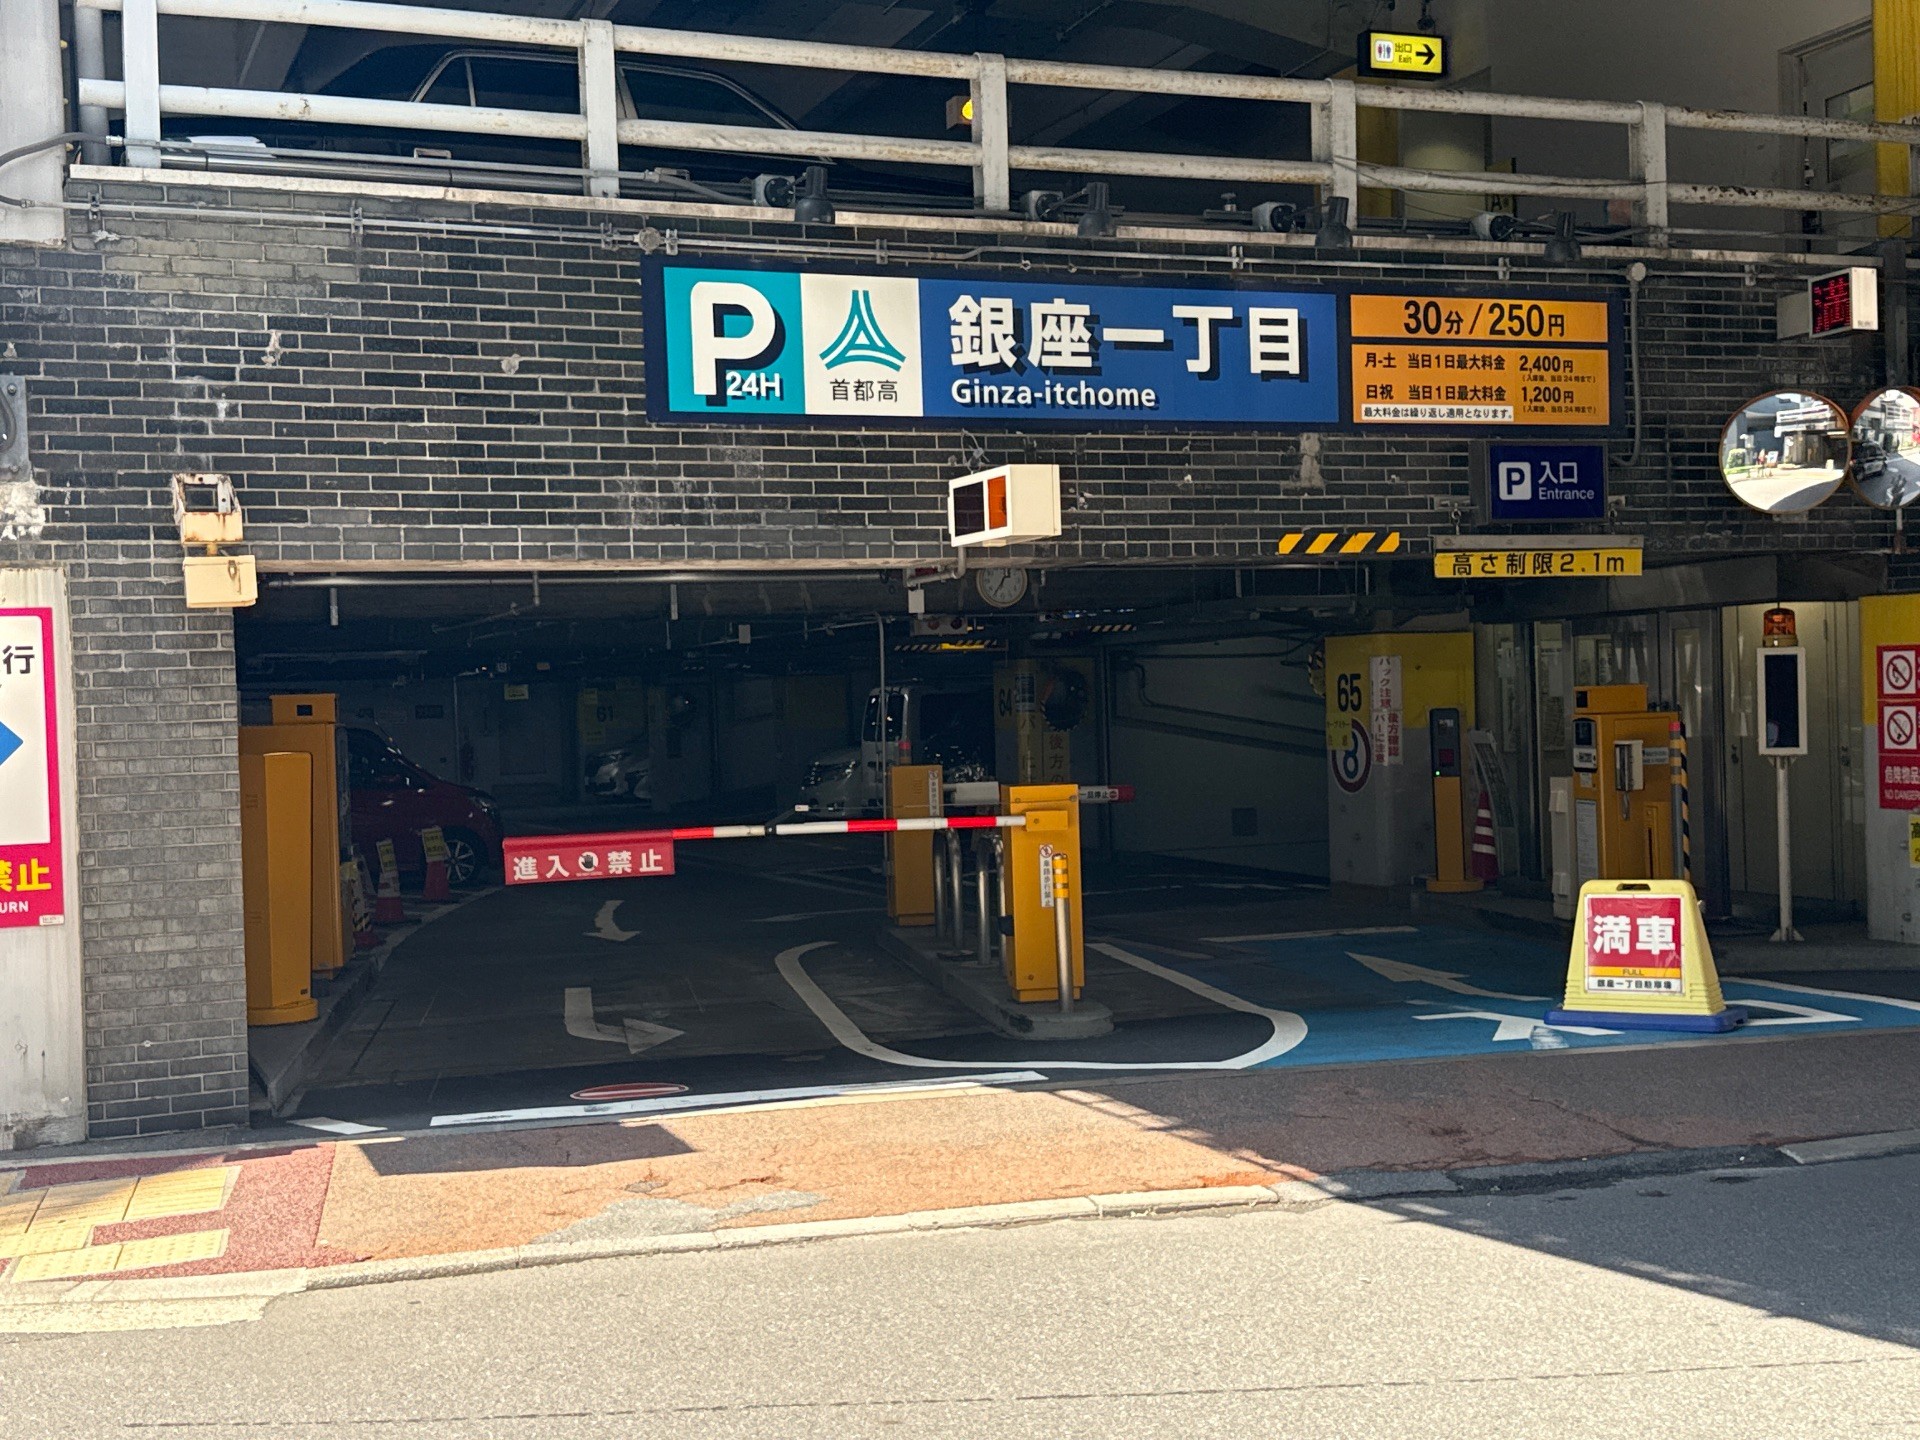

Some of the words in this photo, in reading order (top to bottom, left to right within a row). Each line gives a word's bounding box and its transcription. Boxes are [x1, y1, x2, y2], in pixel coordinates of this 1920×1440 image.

[1395, 43, 1412, 53] 出口
[690, 281, 776, 395] P
[948, 294, 1302, 375] 銀座一丁目
[1407, 354, 1506, 371] 当日1日最大料金
[1519, 355, 1574, 374] 2,400円
[725, 371, 781, 397] 24H
[829, 379, 898, 402] 首都高
[951, 378, 1157, 407] Ginza-itchome
[1365, 384, 1394, 400] 日祝
[1408, 386, 1507, 402] 当日1日最大料金
[1521, 386, 1574, 404] 1,200円
[1363, 407, 1513, 420] 最大料金は繰り返し適用となります。
[1506, 467, 1525, 495] P
[1538, 461, 1578, 485] 入口
[1538, 487, 1595, 500] Entrance
[1452, 552, 1624, 575] 高さ制限2.1m
[1337, 673, 1362, 712] 65
[513, 855, 570, 881] 進入
[607, 848, 664, 875] 禁止
[1593, 915, 1676, 955] 満車
[1622, 968, 1645, 976] FULL
